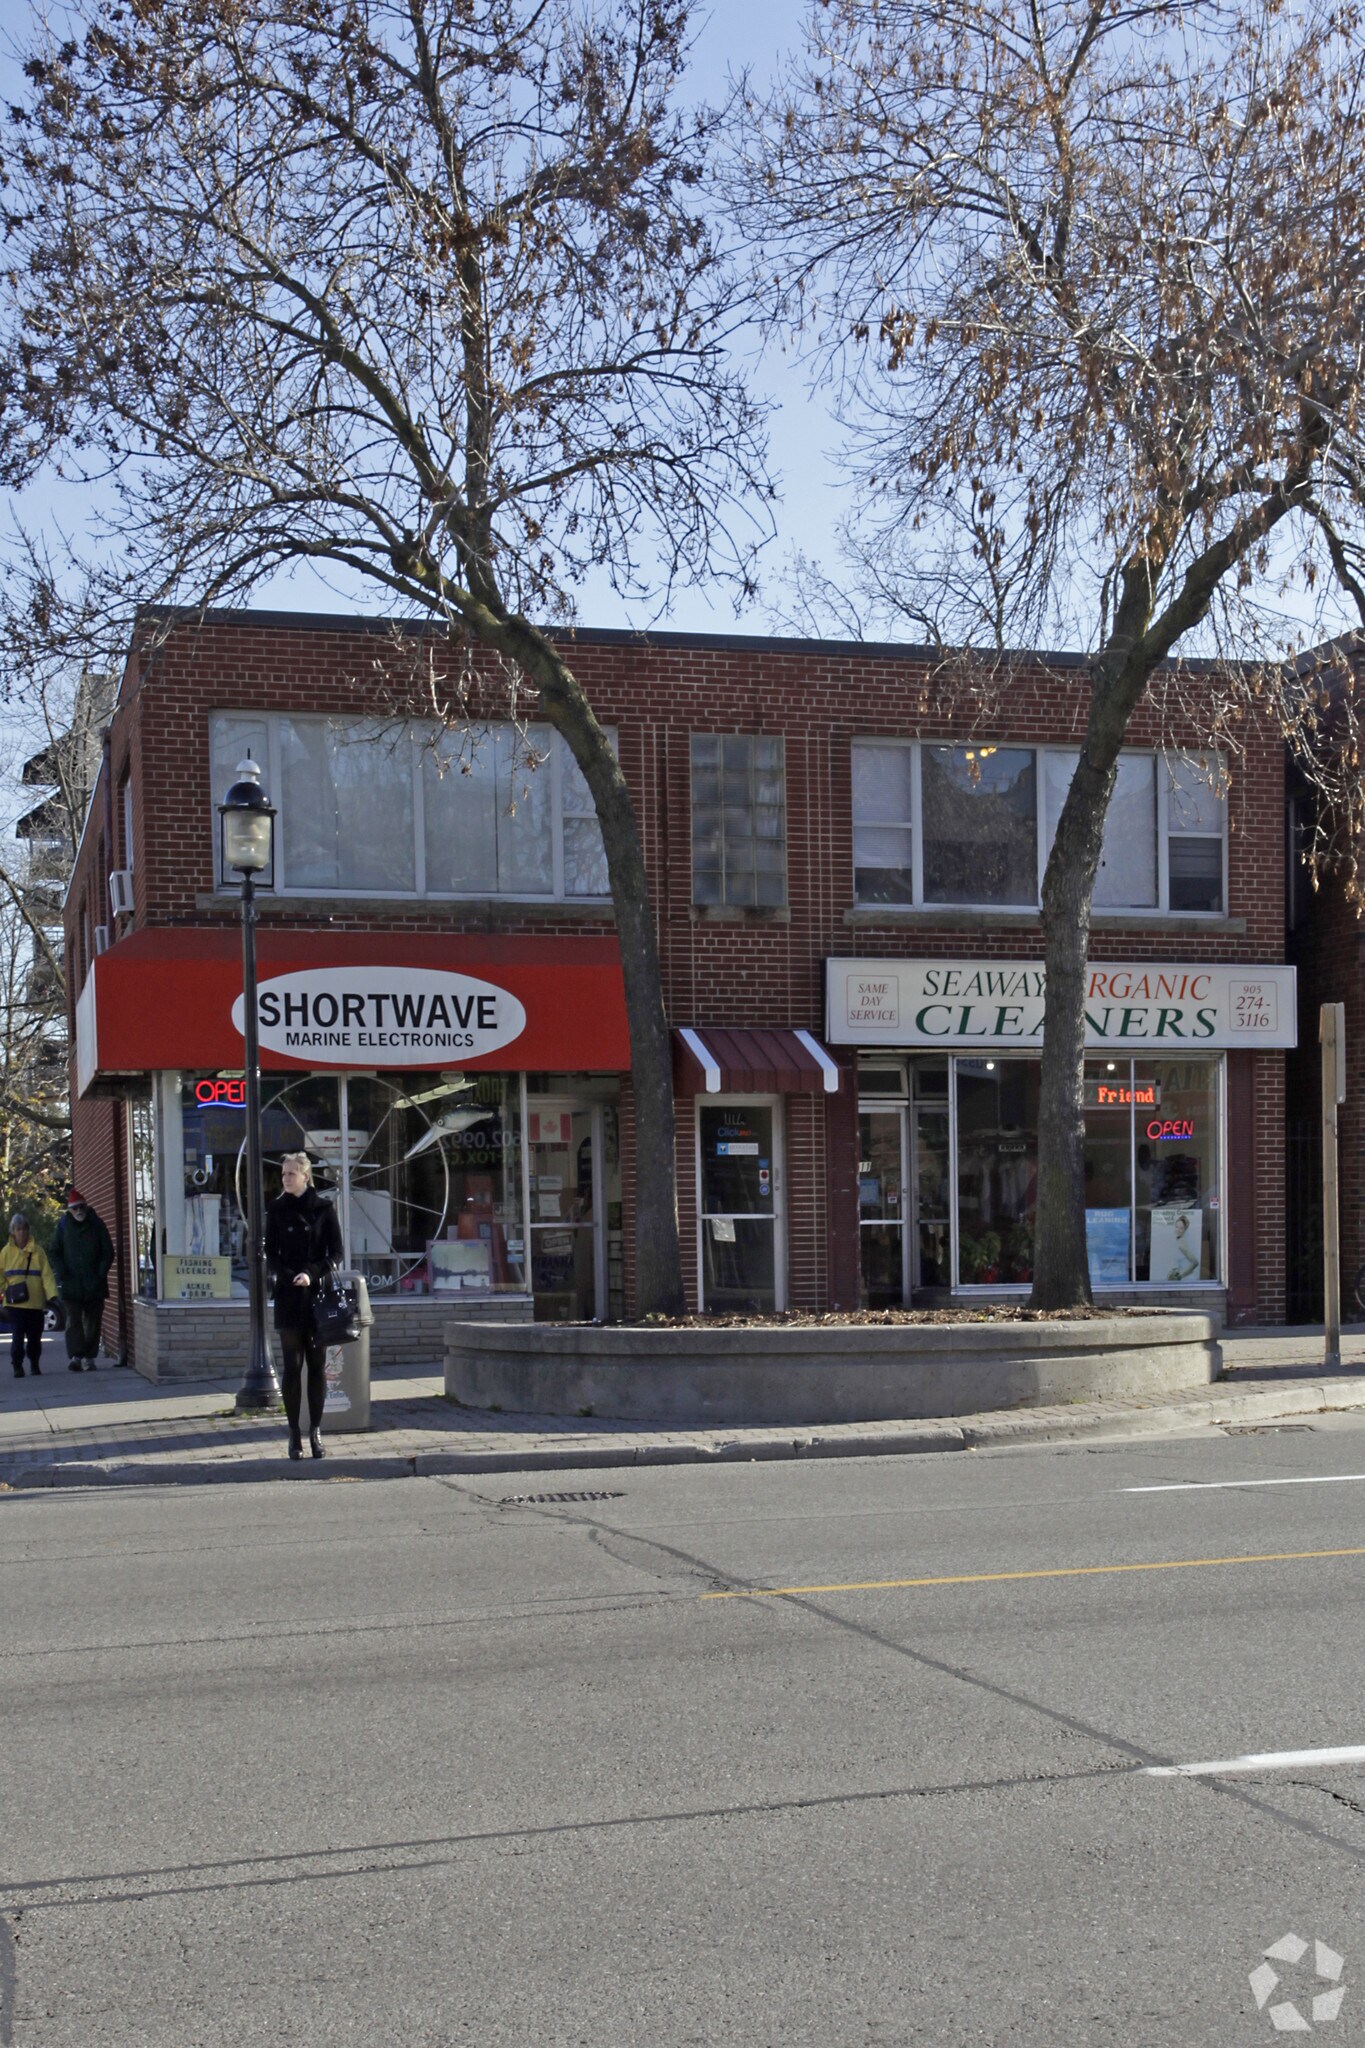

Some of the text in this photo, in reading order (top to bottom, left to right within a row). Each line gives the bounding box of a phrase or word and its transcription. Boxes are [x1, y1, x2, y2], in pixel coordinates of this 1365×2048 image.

[857, 983, 889, 994] SAME
[922, 970, 1212, 1000] SEAWAY RGANIC
[1242, 985, 1262, 995] 905
[860, 996, 884, 1006] DAY
[258, 991, 498, 1030] SHORTWAVE
[849, 1009, 896, 1022] SERVICE
[1235, 1012, 1270, 1028] 3116
[285, 1032, 474, 1048] MARINE ELECTRONICS
[1097, 1087, 1154, 1104] Friend
[1146, 1120, 1194, 1140] OPEN
[544, 1236, 571, 1248] OPEN
[179, 1258, 213, 1267] FISHING
[176, 1267, 217, 1275] LICENCES
